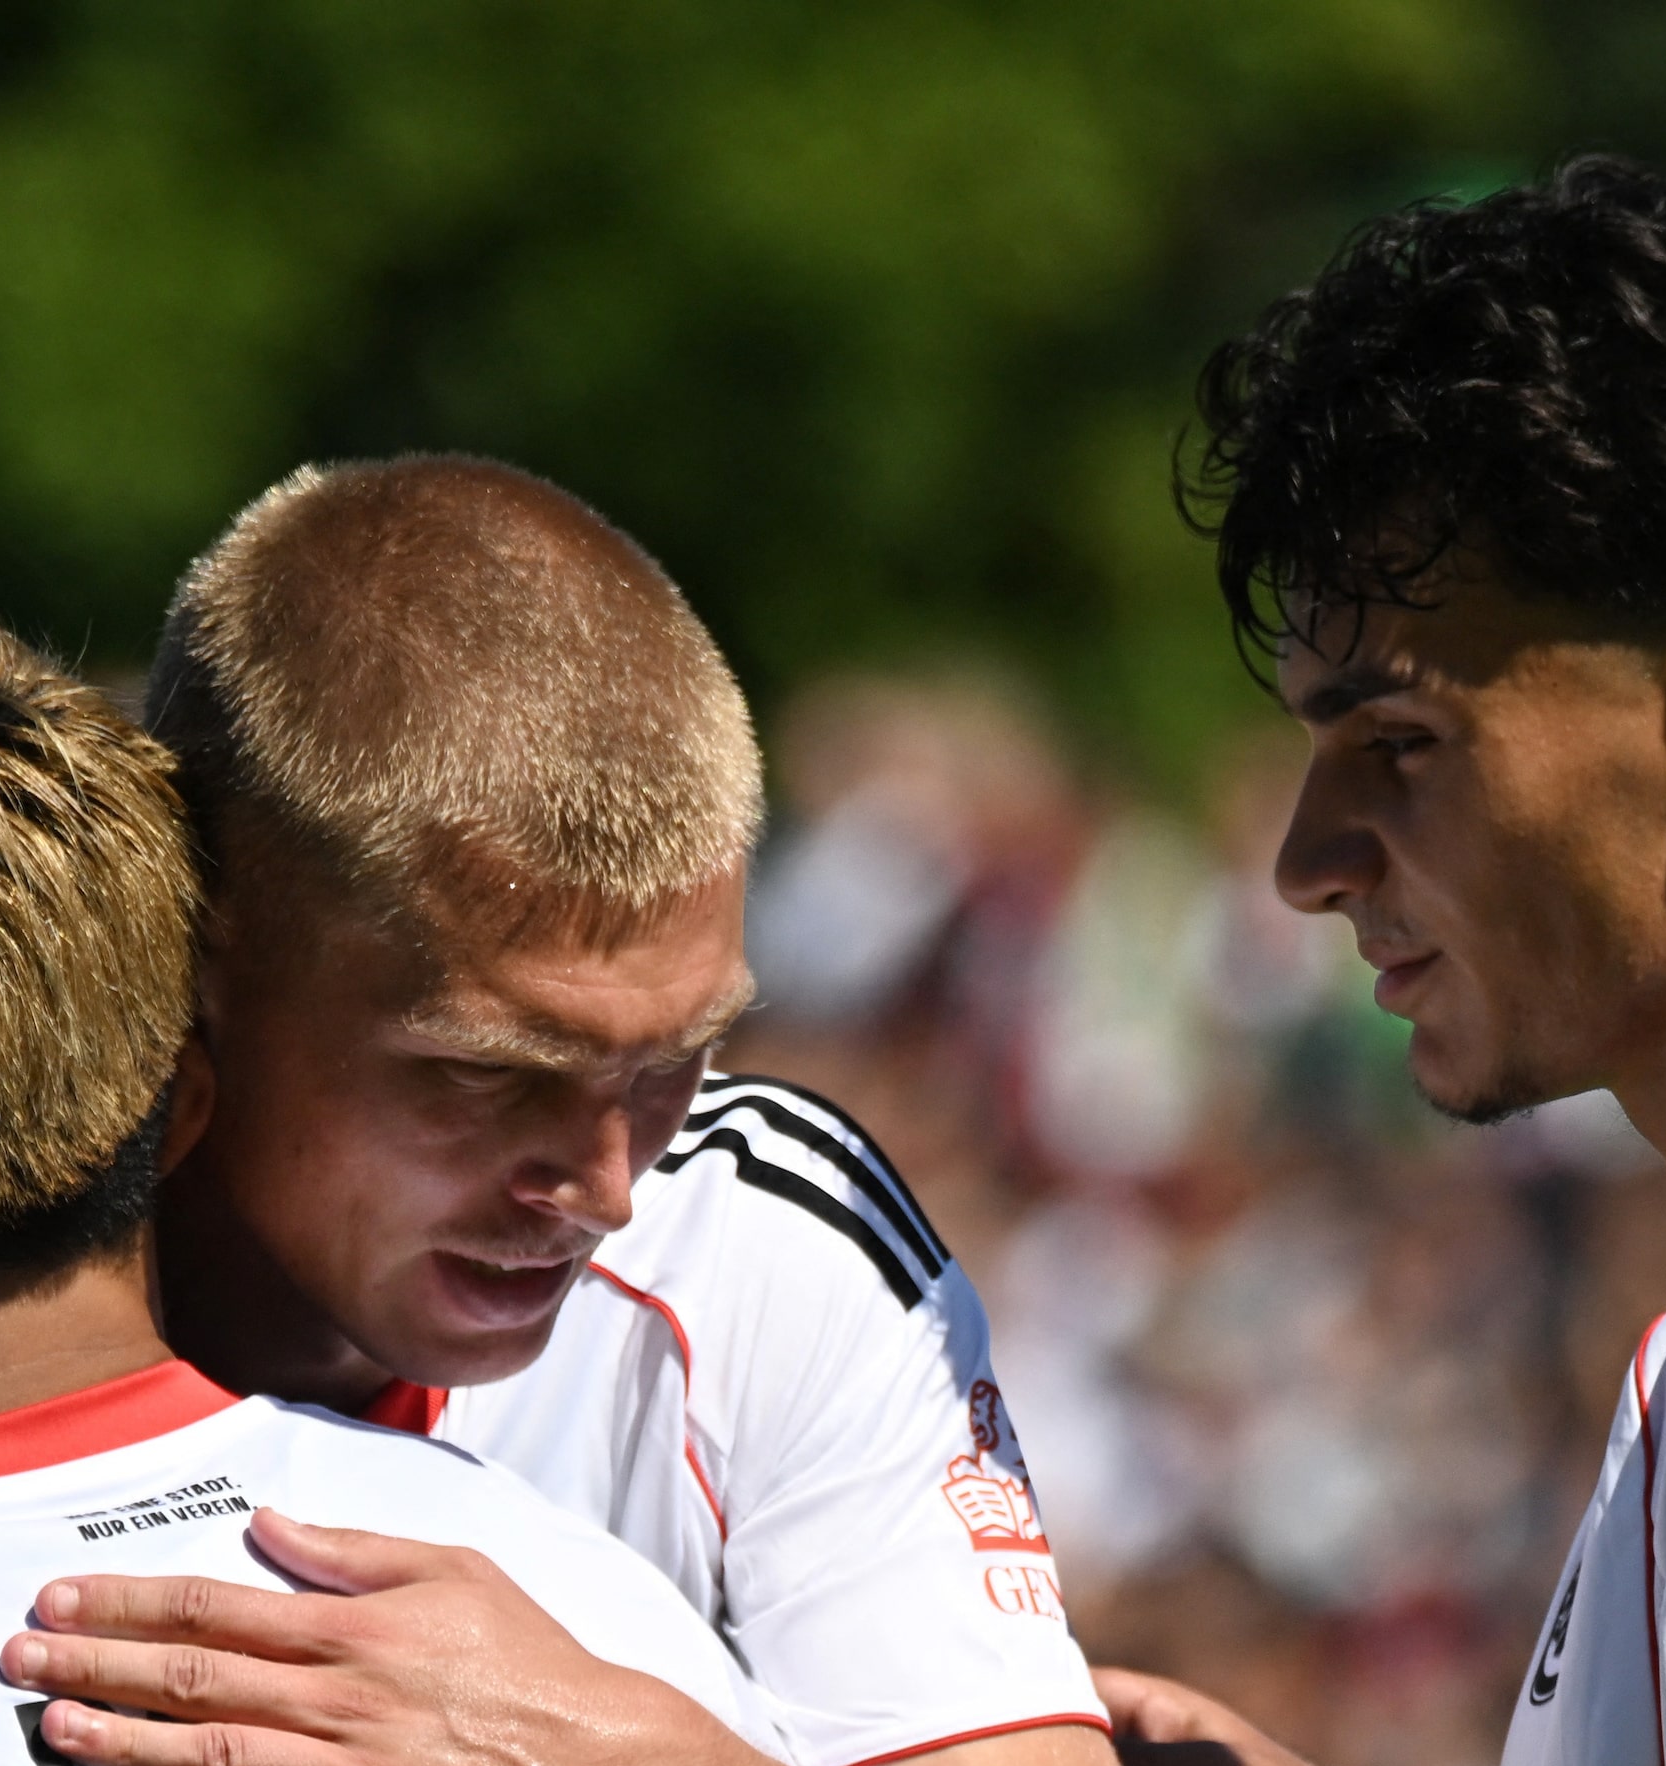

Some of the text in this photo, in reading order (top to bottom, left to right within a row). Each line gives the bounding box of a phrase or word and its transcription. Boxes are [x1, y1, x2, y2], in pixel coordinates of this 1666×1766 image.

[164, 1476, 243, 1502] STADT.
[77, 1518, 130, 1542] NUR
[129, 1511, 172, 1531] EIN
[169, 1495, 259, 1522] VEREIN.
